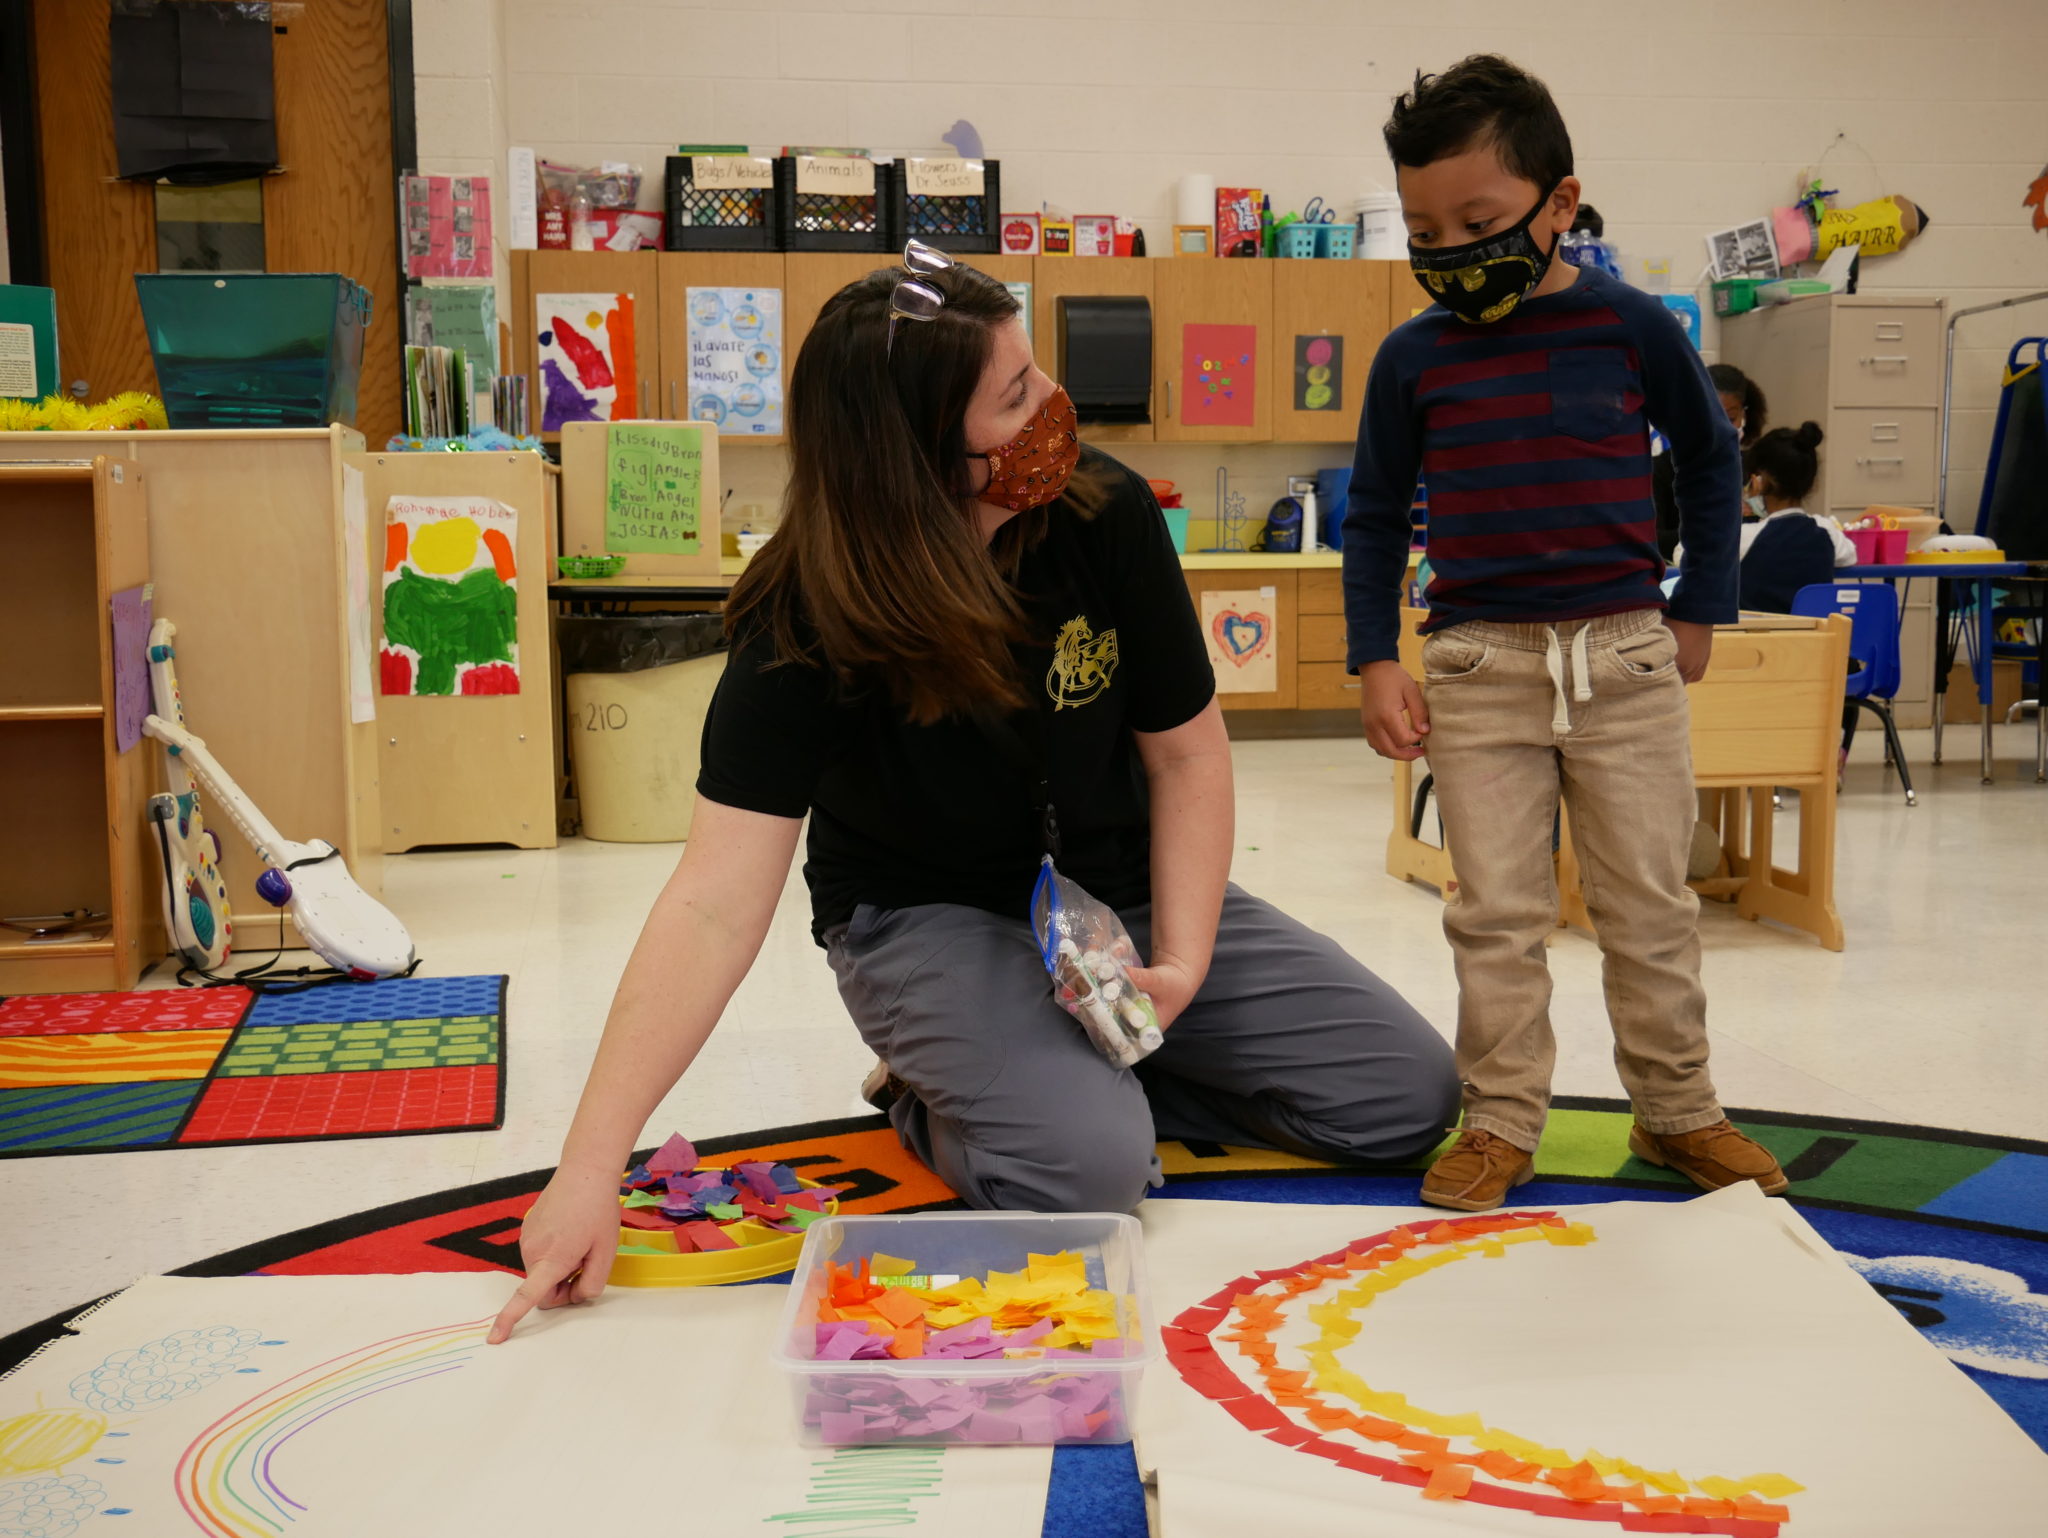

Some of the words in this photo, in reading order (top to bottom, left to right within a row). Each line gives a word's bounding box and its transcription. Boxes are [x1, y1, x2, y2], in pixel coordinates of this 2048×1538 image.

[806, 160, 864, 177] Animals
[617, 524, 680, 539] JOSIAS
[586, 702, 628, 731] 210
